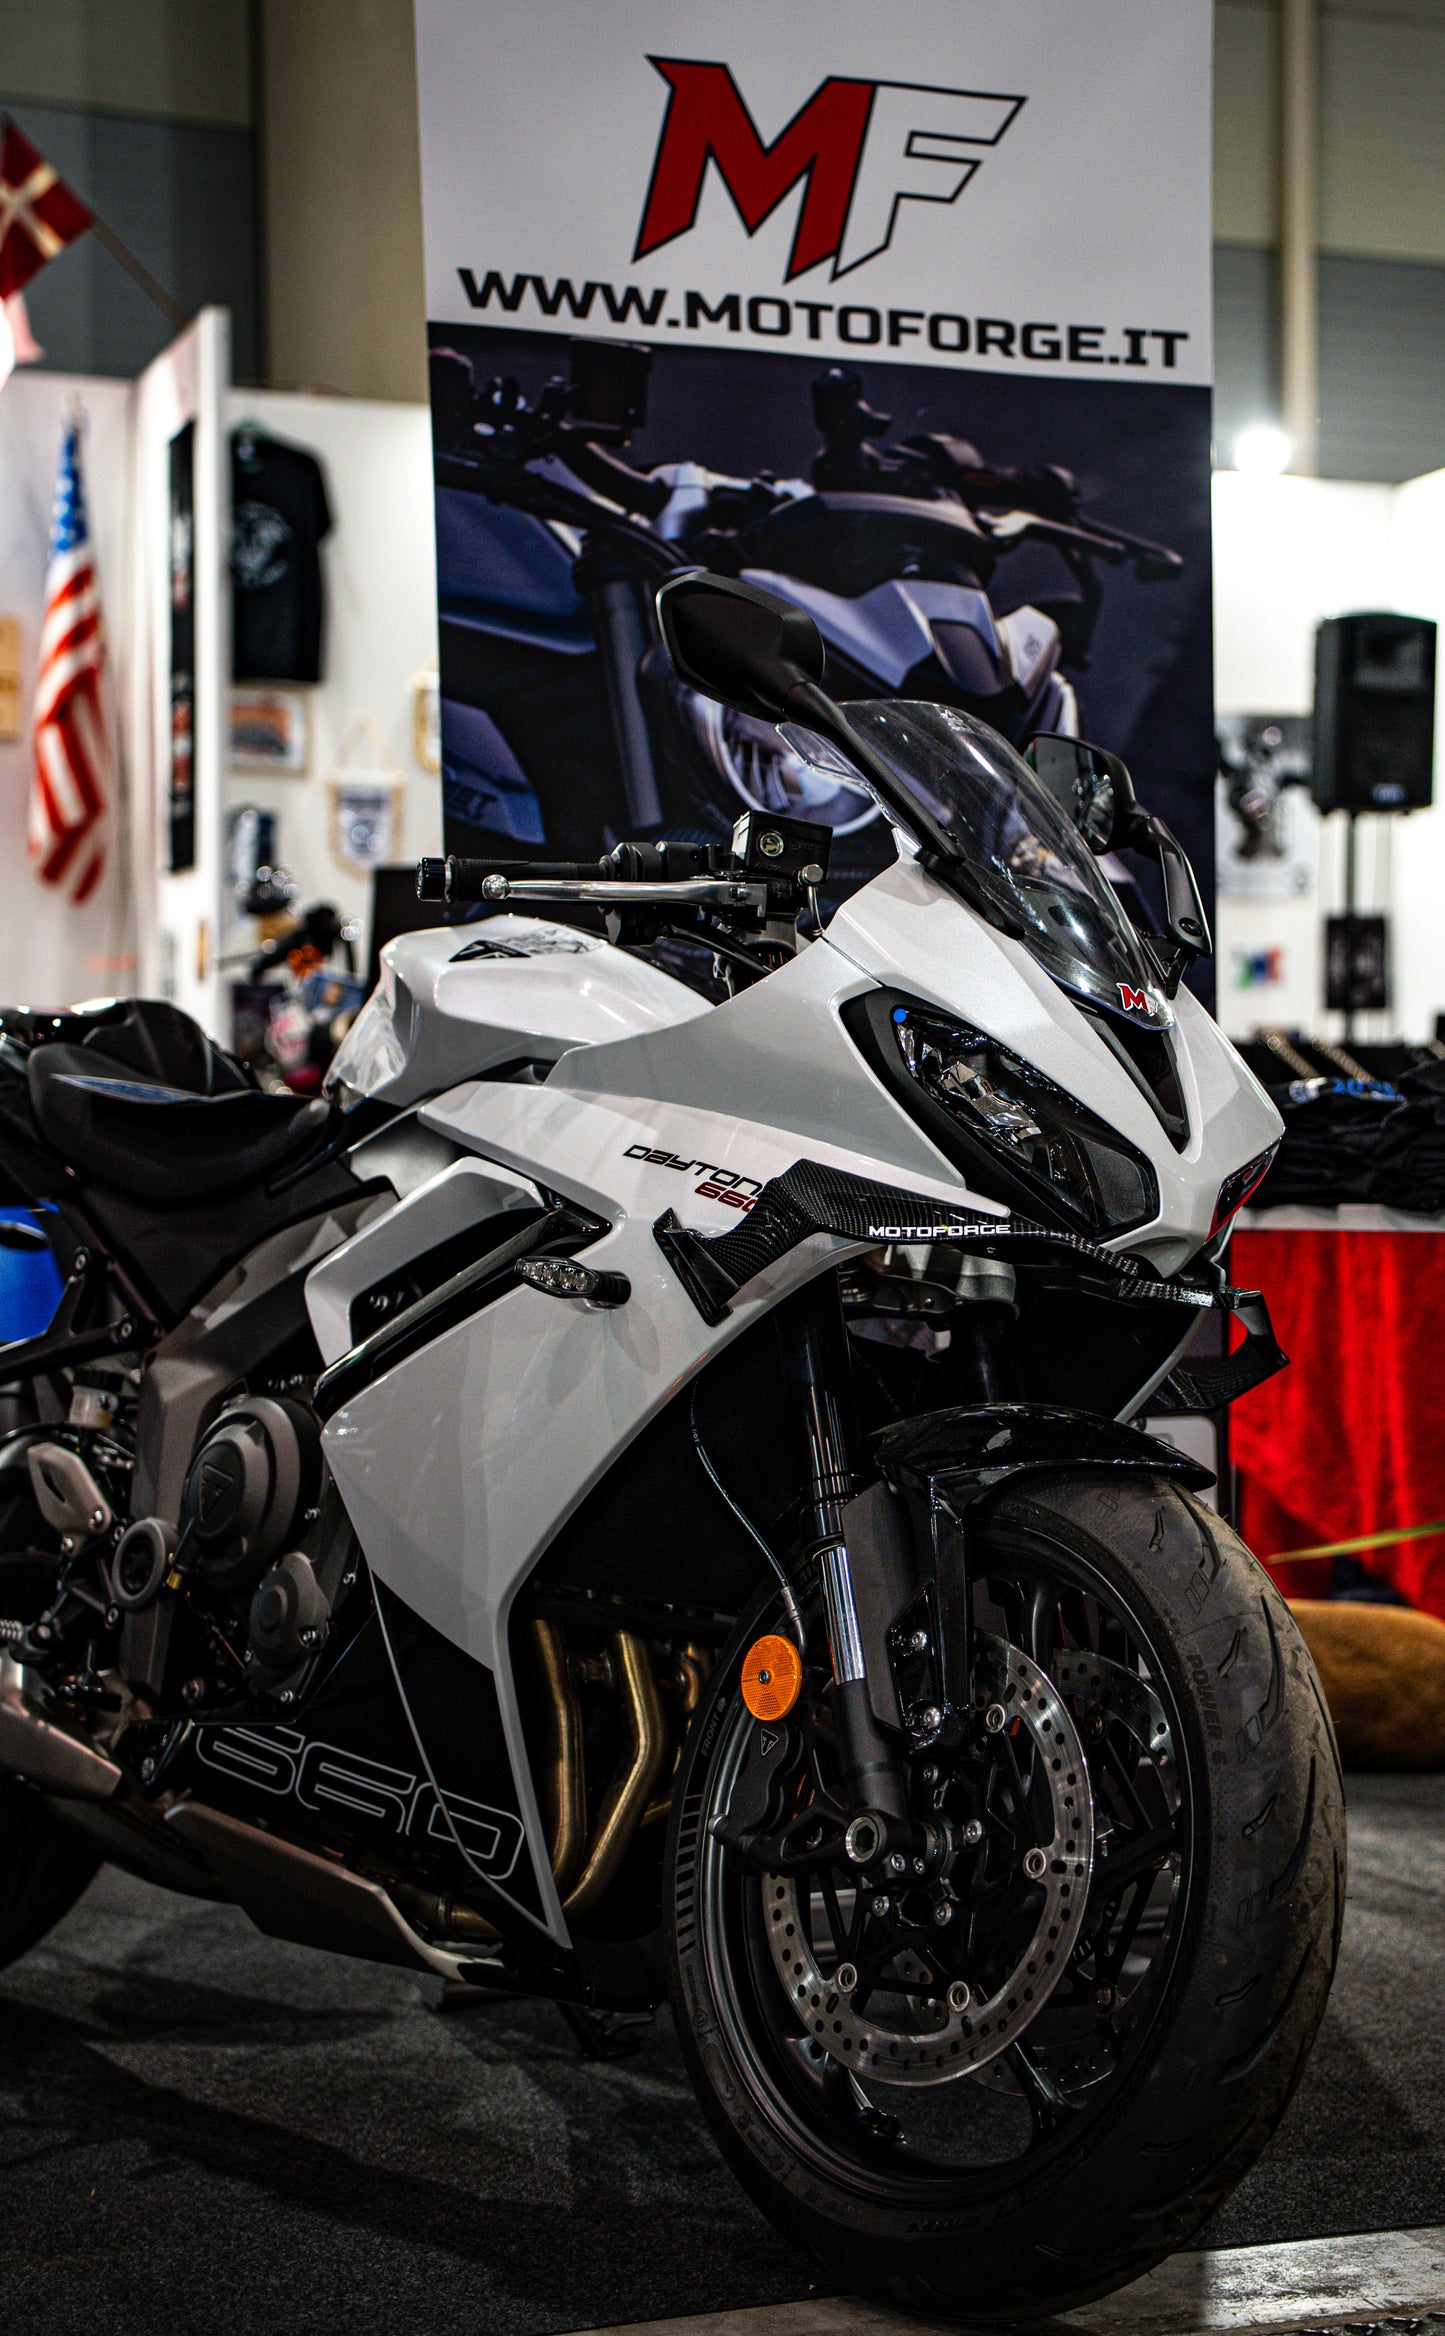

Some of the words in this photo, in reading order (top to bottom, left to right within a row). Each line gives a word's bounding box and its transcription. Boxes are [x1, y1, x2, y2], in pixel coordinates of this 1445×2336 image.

[632, 53, 1028, 284] MF
[456, 266, 1189, 369] WWW.MOTOFORGE.IT
[622, 1144, 763, 1197] DAYTON
[868, 1224, 1011, 1238] MOTOFORGE
[700, 1711, 719, 1757] FRONT
[1187, 1653, 1223, 1739] POWER
[195, 1725, 525, 1880] 660
